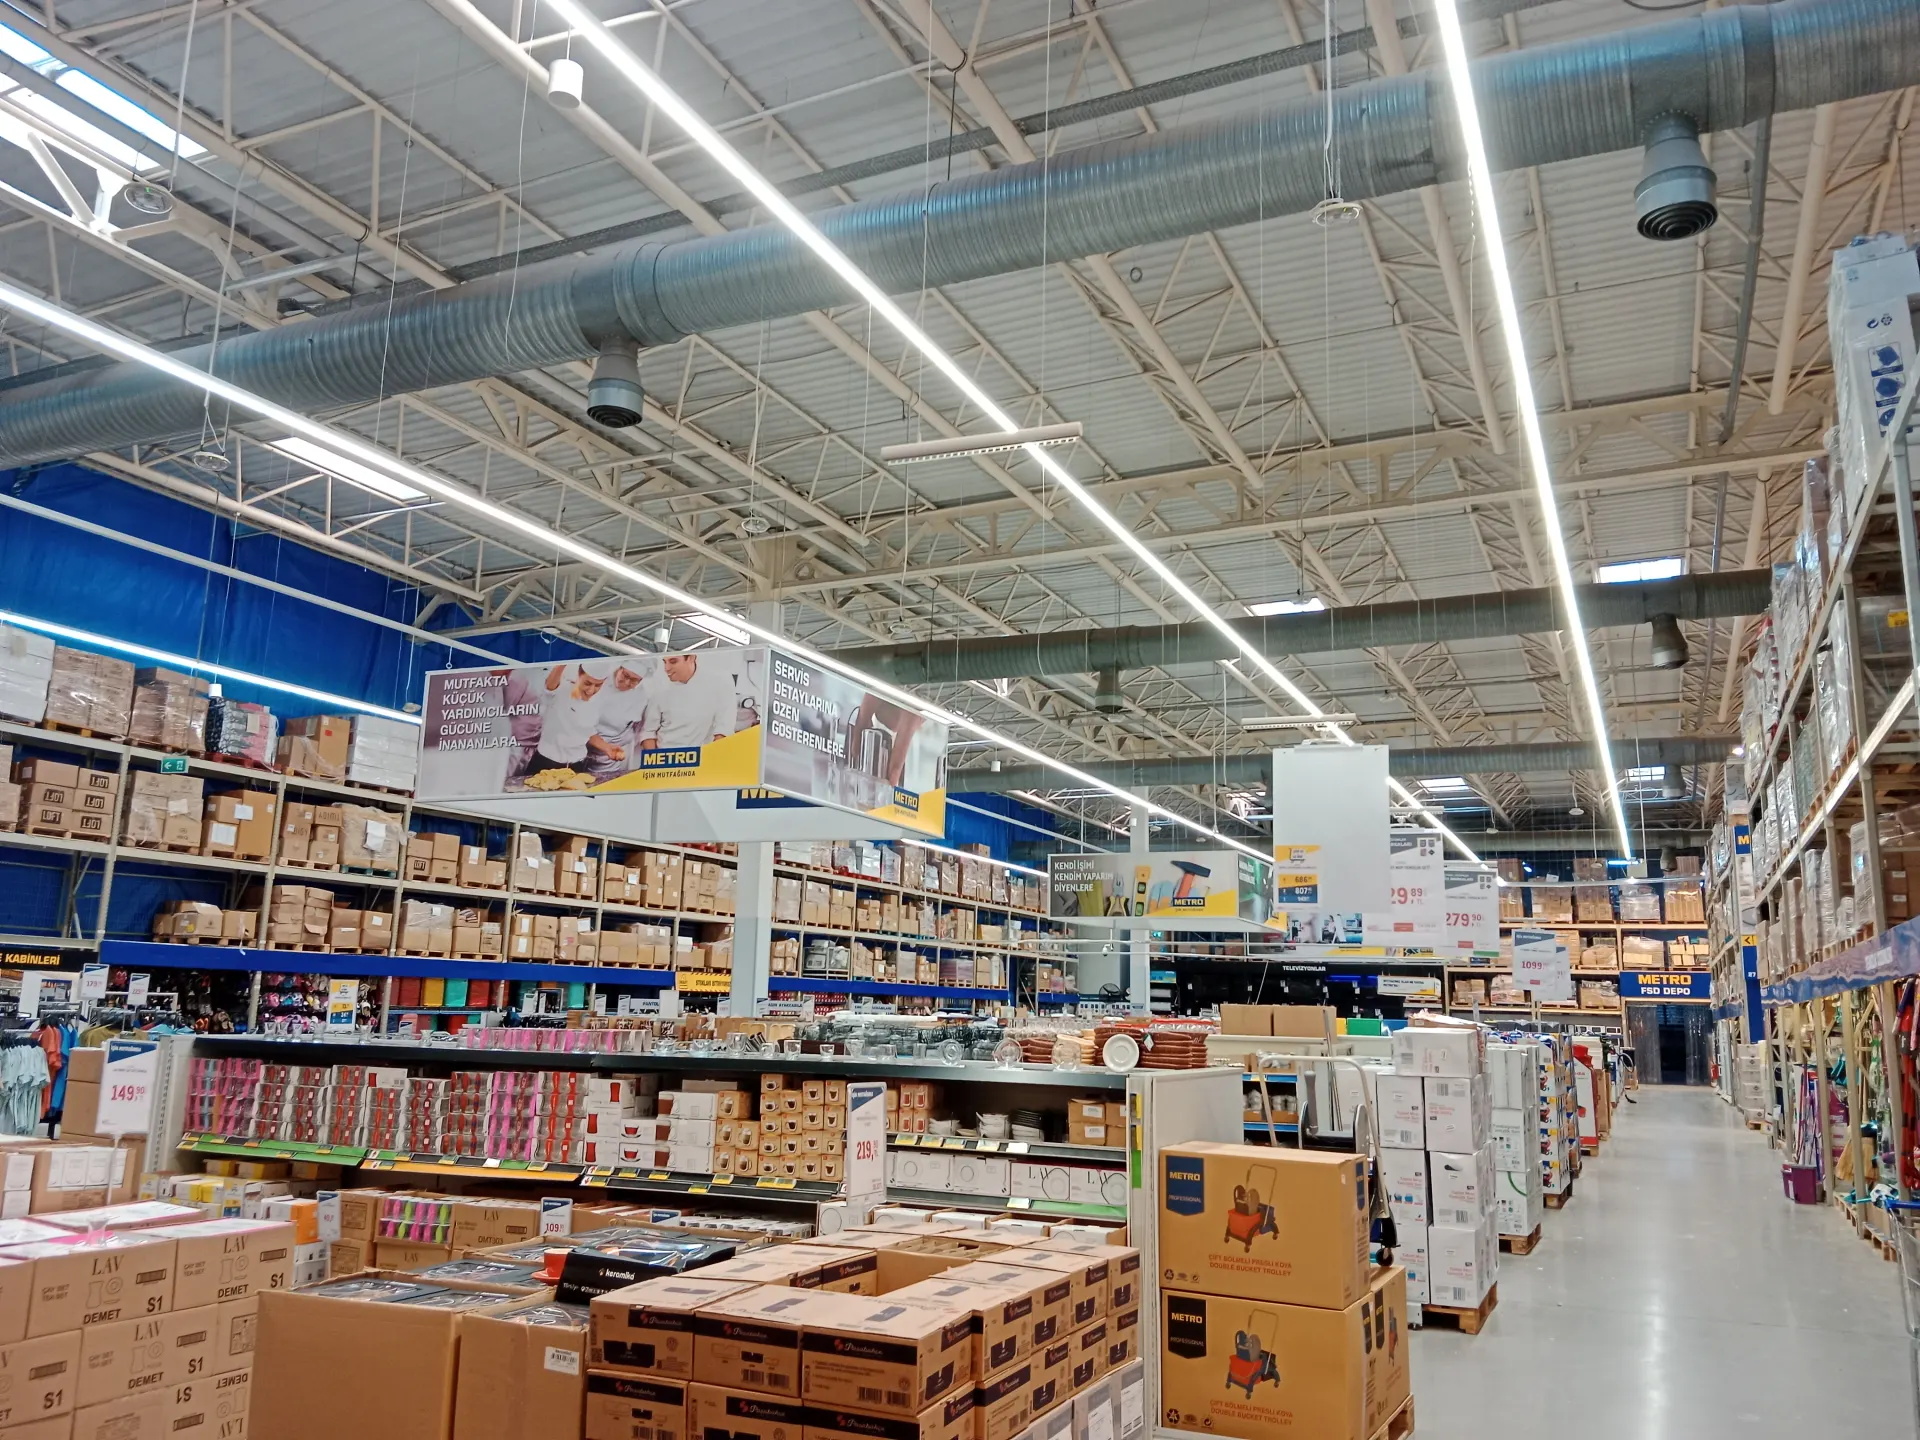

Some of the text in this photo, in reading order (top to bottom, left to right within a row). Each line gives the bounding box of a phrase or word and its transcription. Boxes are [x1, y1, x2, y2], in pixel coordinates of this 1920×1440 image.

[774, 659, 810, 687] SERVİS
[444, 675, 509, 690] MUTFAKTA
[442, 690, 485, 706] KÜÇÜK
[773, 680, 838, 717] DETAYLARINA
[441, 703, 540, 720] YARDIMCILARIN
[772, 697, 800, 723] ÖZEN
[440, 721, 491, 736] GÜCÜNE
[438, 736, 521, 751] İNANANLARA.
[771, 719, 846, 759] GÖSTERENLERE.
[643, 751, 697, 766] METRO
[894, 789, 918, 808] METRO
[42, 810, 61, 821] LOFT
[1054, 859, 1076, 870] KENDİ
[1054, 870, 1081, 881] KENDİM
[1054, 881, 1094, 892] DİYENLERE
[1175, 898, 1204, 906] METRO
[5, 953, 61, 966] KABİNLERİ
[1638, 974, 1692, 985] METRO
[1640, 986, 1691, 995] FSD DEPO
[1169, 1171, 1201, 1181] METRO
[223, 1235, 249, 1254] LAV
[92, 1255, 125, 1276] LAV
[270, 1272, 285, 1288] S1
[218, 1283, 250, 1299] DEMET
[147, 1295, 163, 1313] S1
[83, 1308, 122, 1326] DEMET
[1171, 1311, 1203, 1324] METRO
[134, 1320, 165, 1342] LAV
[188, 1356, 204, 1375] S1
[128, 1371, 165, 1390] DEMET
[216, 1372, 249, 1390] DEMET
[43, 1389, 64, 1410] S1
[176, 1386, 193, 1405] S1
